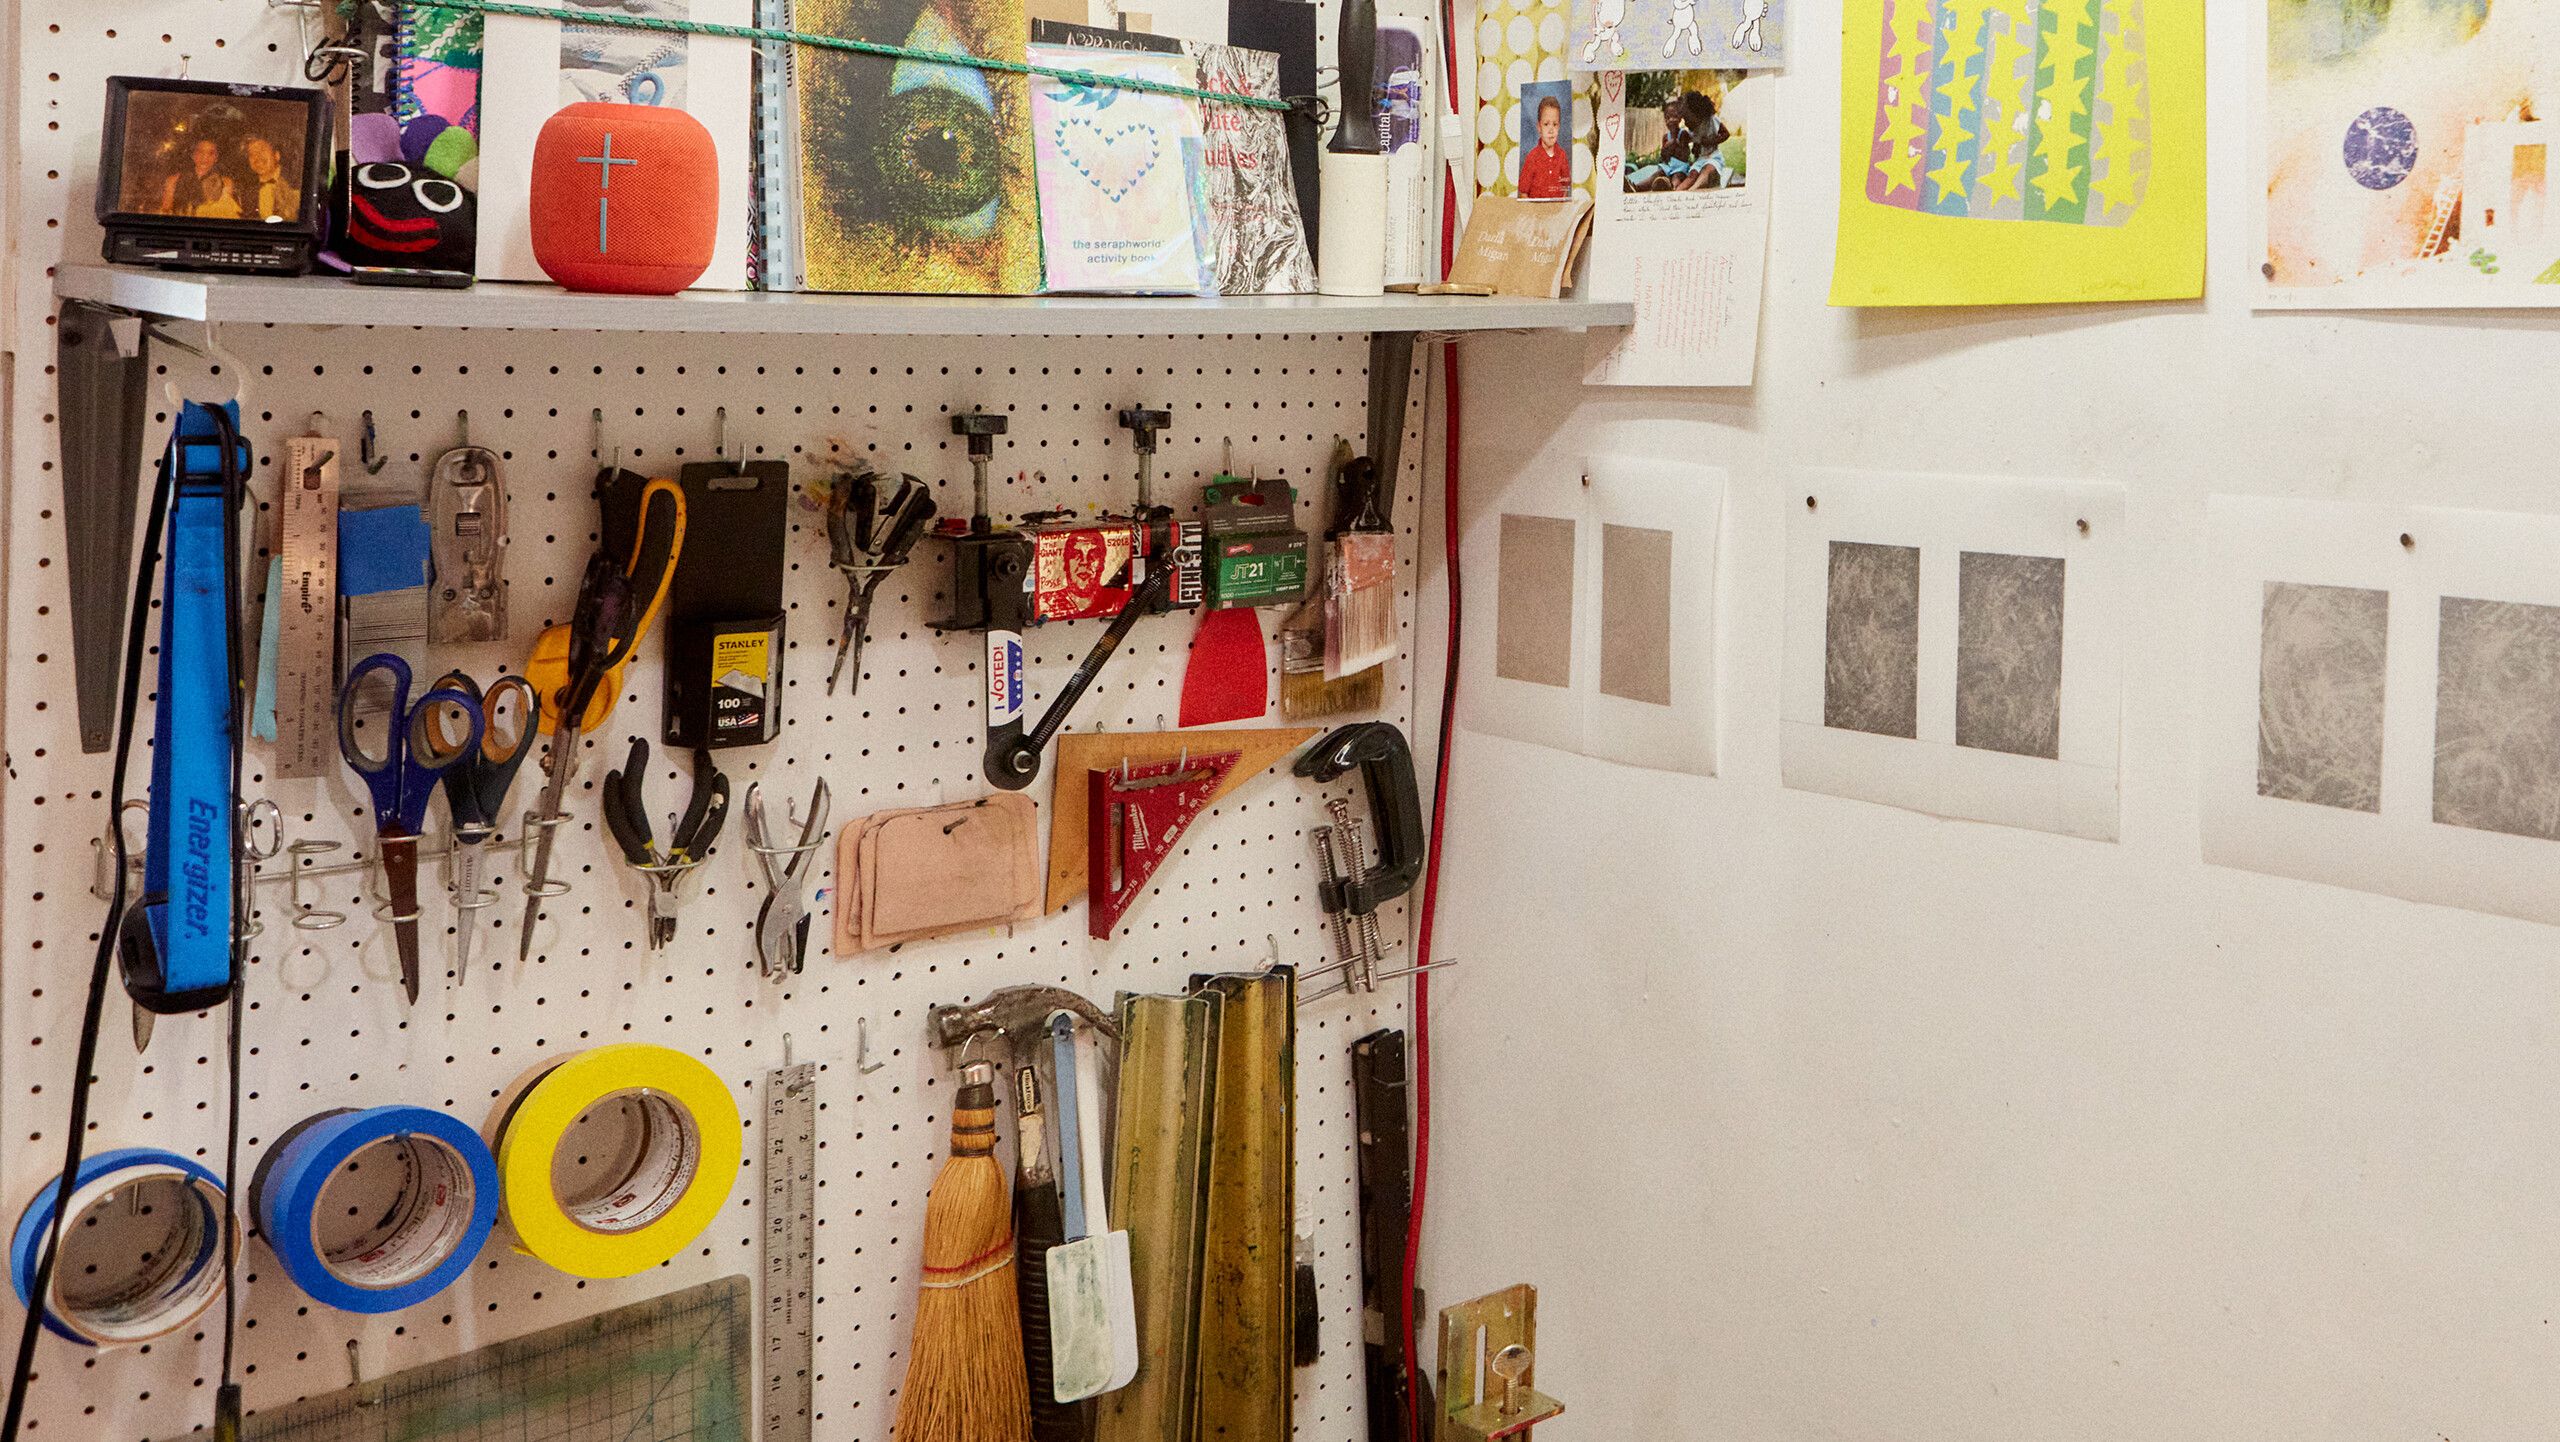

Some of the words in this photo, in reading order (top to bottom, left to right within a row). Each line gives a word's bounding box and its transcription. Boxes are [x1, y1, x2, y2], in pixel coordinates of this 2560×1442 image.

[1073, 240, 1091, 249] the
[1087, 254, 1128, 265] activity
[1041, 549, 1063, 558] GIANT
[1231, 562, 1264, 580] JT21
[719, 639, 764, 650] STANLEY
[718, 698, 740, 709] 100
[718, 717, 737, 727] USA
[1130, 802, 1147, 852] Milwaukee
[775, 1070, 784, 1086] 24
[775, 1099, 784, 1115] 23
[774, 1138, 784, 1154] 22
[774, 1179, 784, 1193] 21
[773, 1217, 783, 1233] 20
[773, 1258, 782, 1273] 19
[772, 1296, 782, 1312] 18
[772, 1337, 781, 1351] 17
[771, 1375, 781, 1391] 16
[771, 1415, 780, 1430] 15
